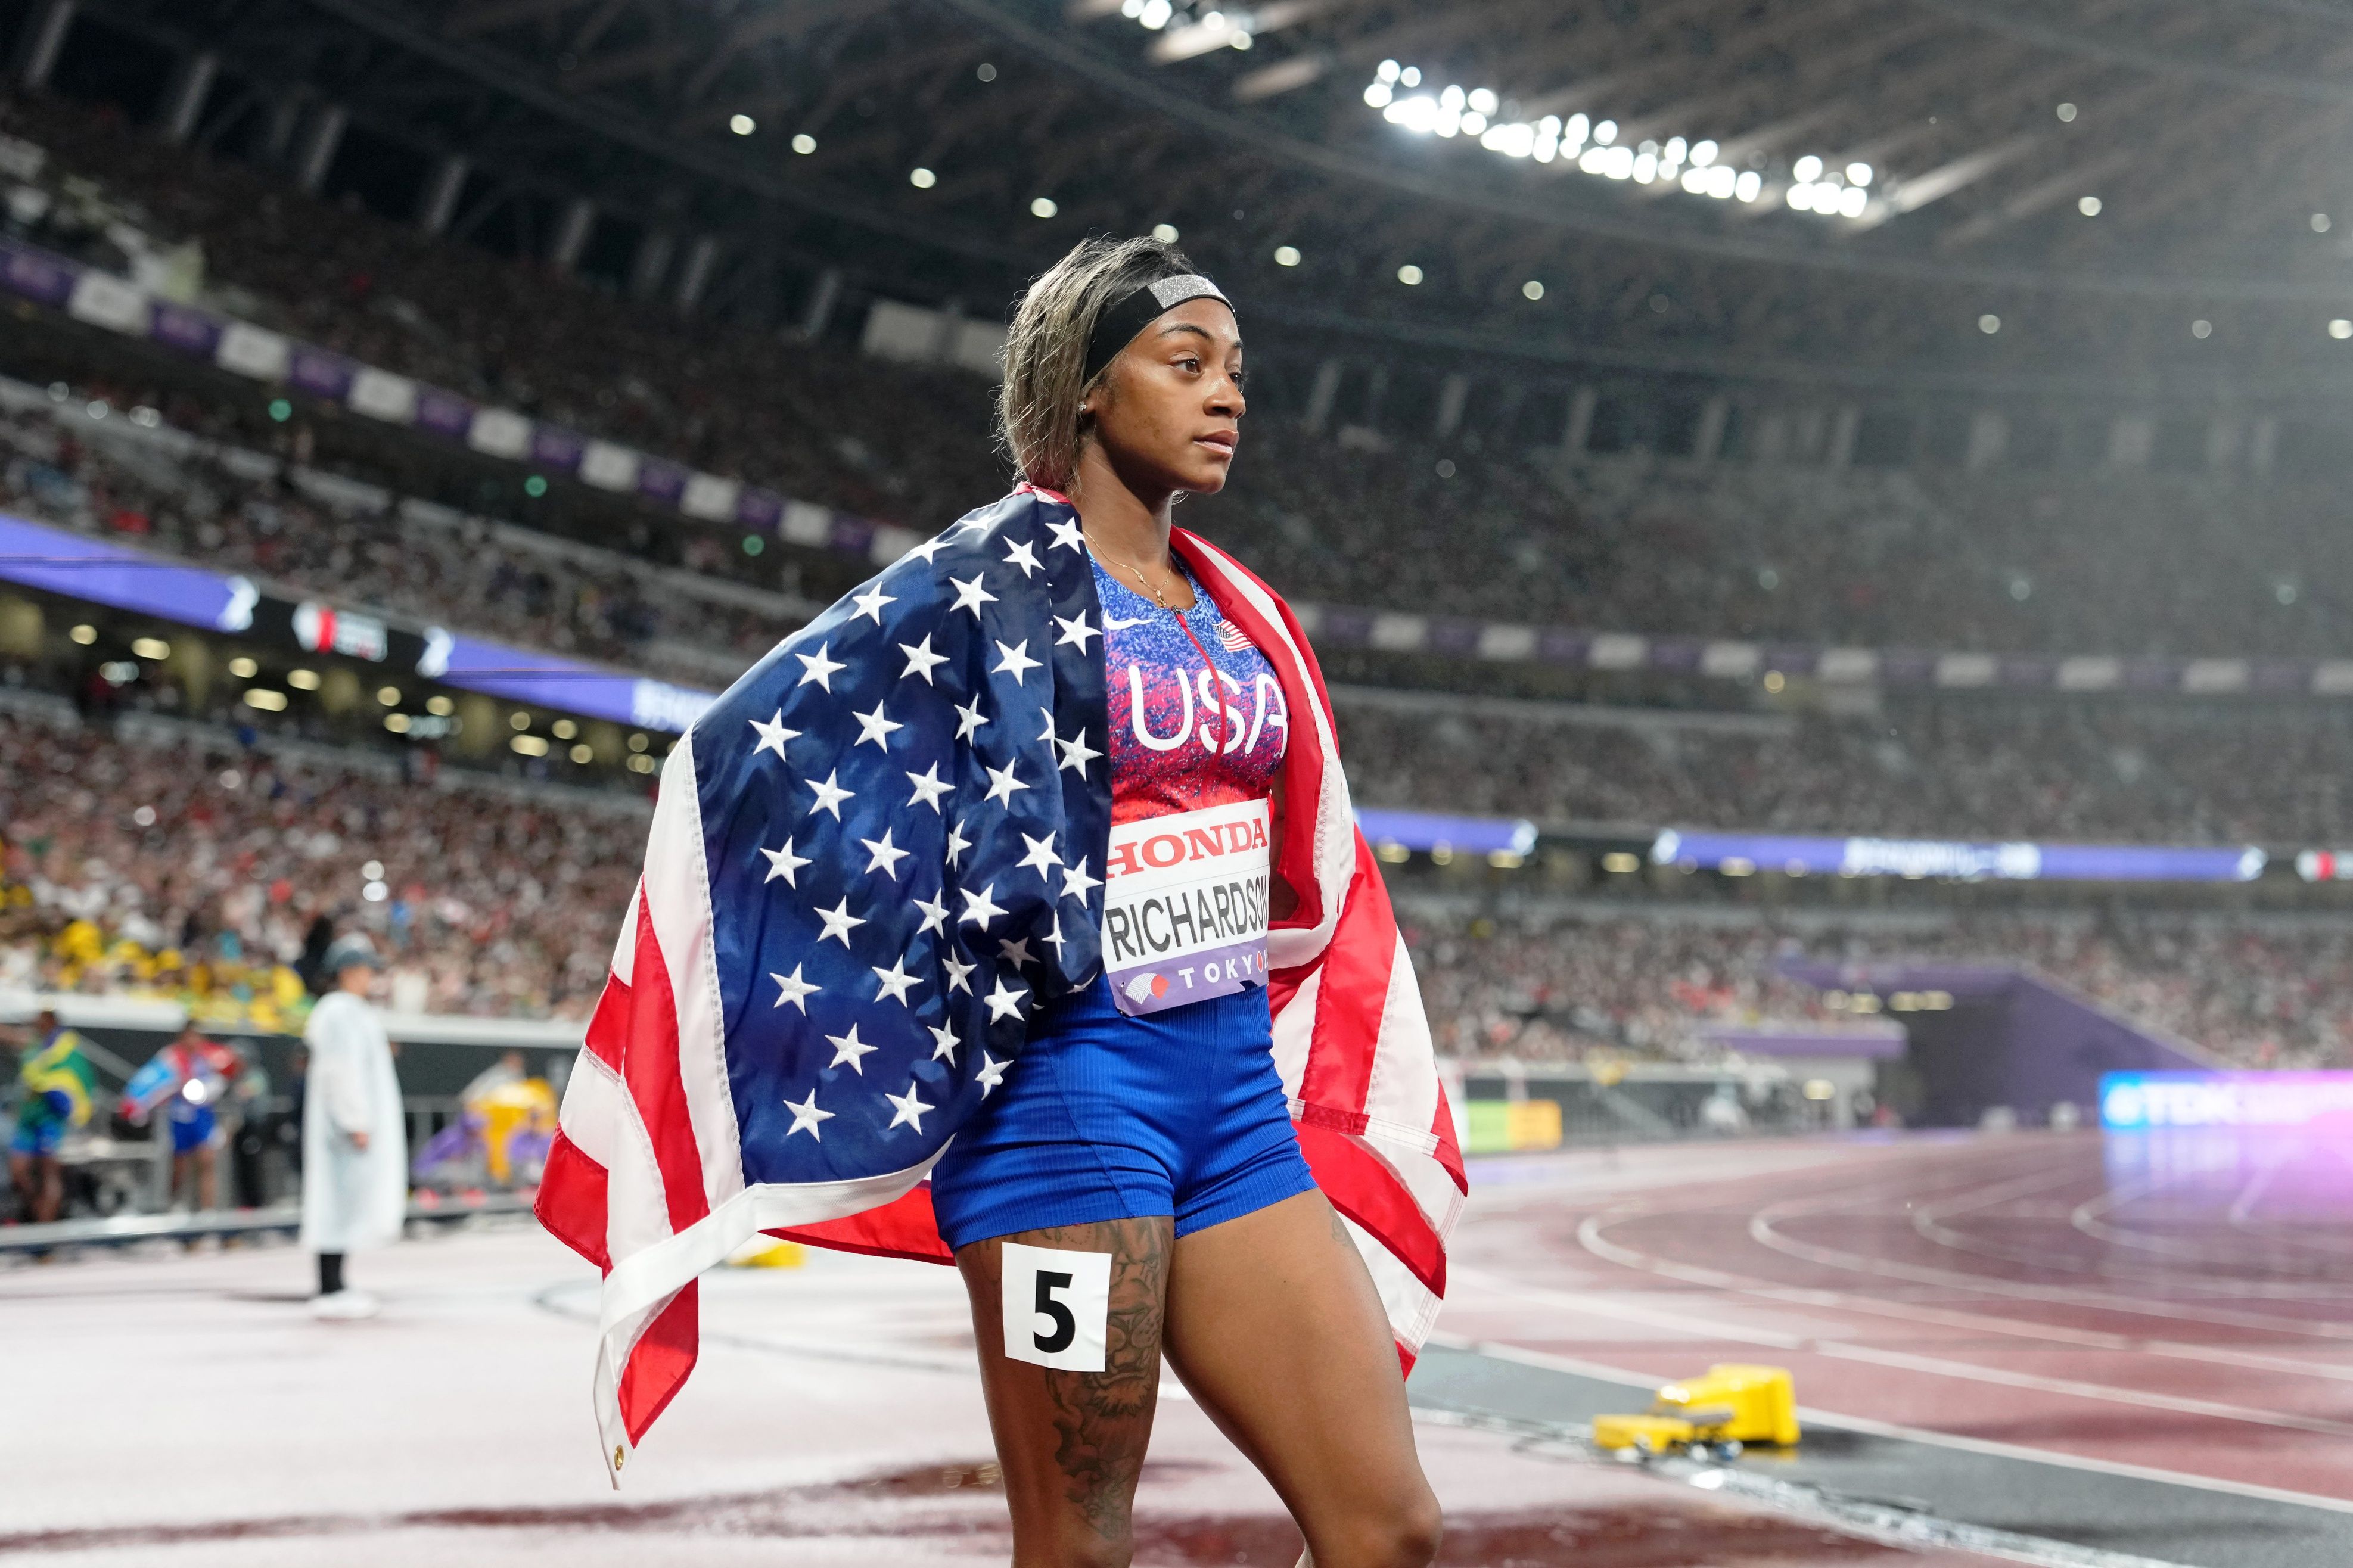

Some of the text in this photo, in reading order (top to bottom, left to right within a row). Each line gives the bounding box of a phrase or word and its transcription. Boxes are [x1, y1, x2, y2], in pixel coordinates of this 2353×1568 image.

[1128, 665, 1288, 758] USA
[1106, 817, 1268, 879] HONDA
[1033, 1269, 1076, 1354] 5
